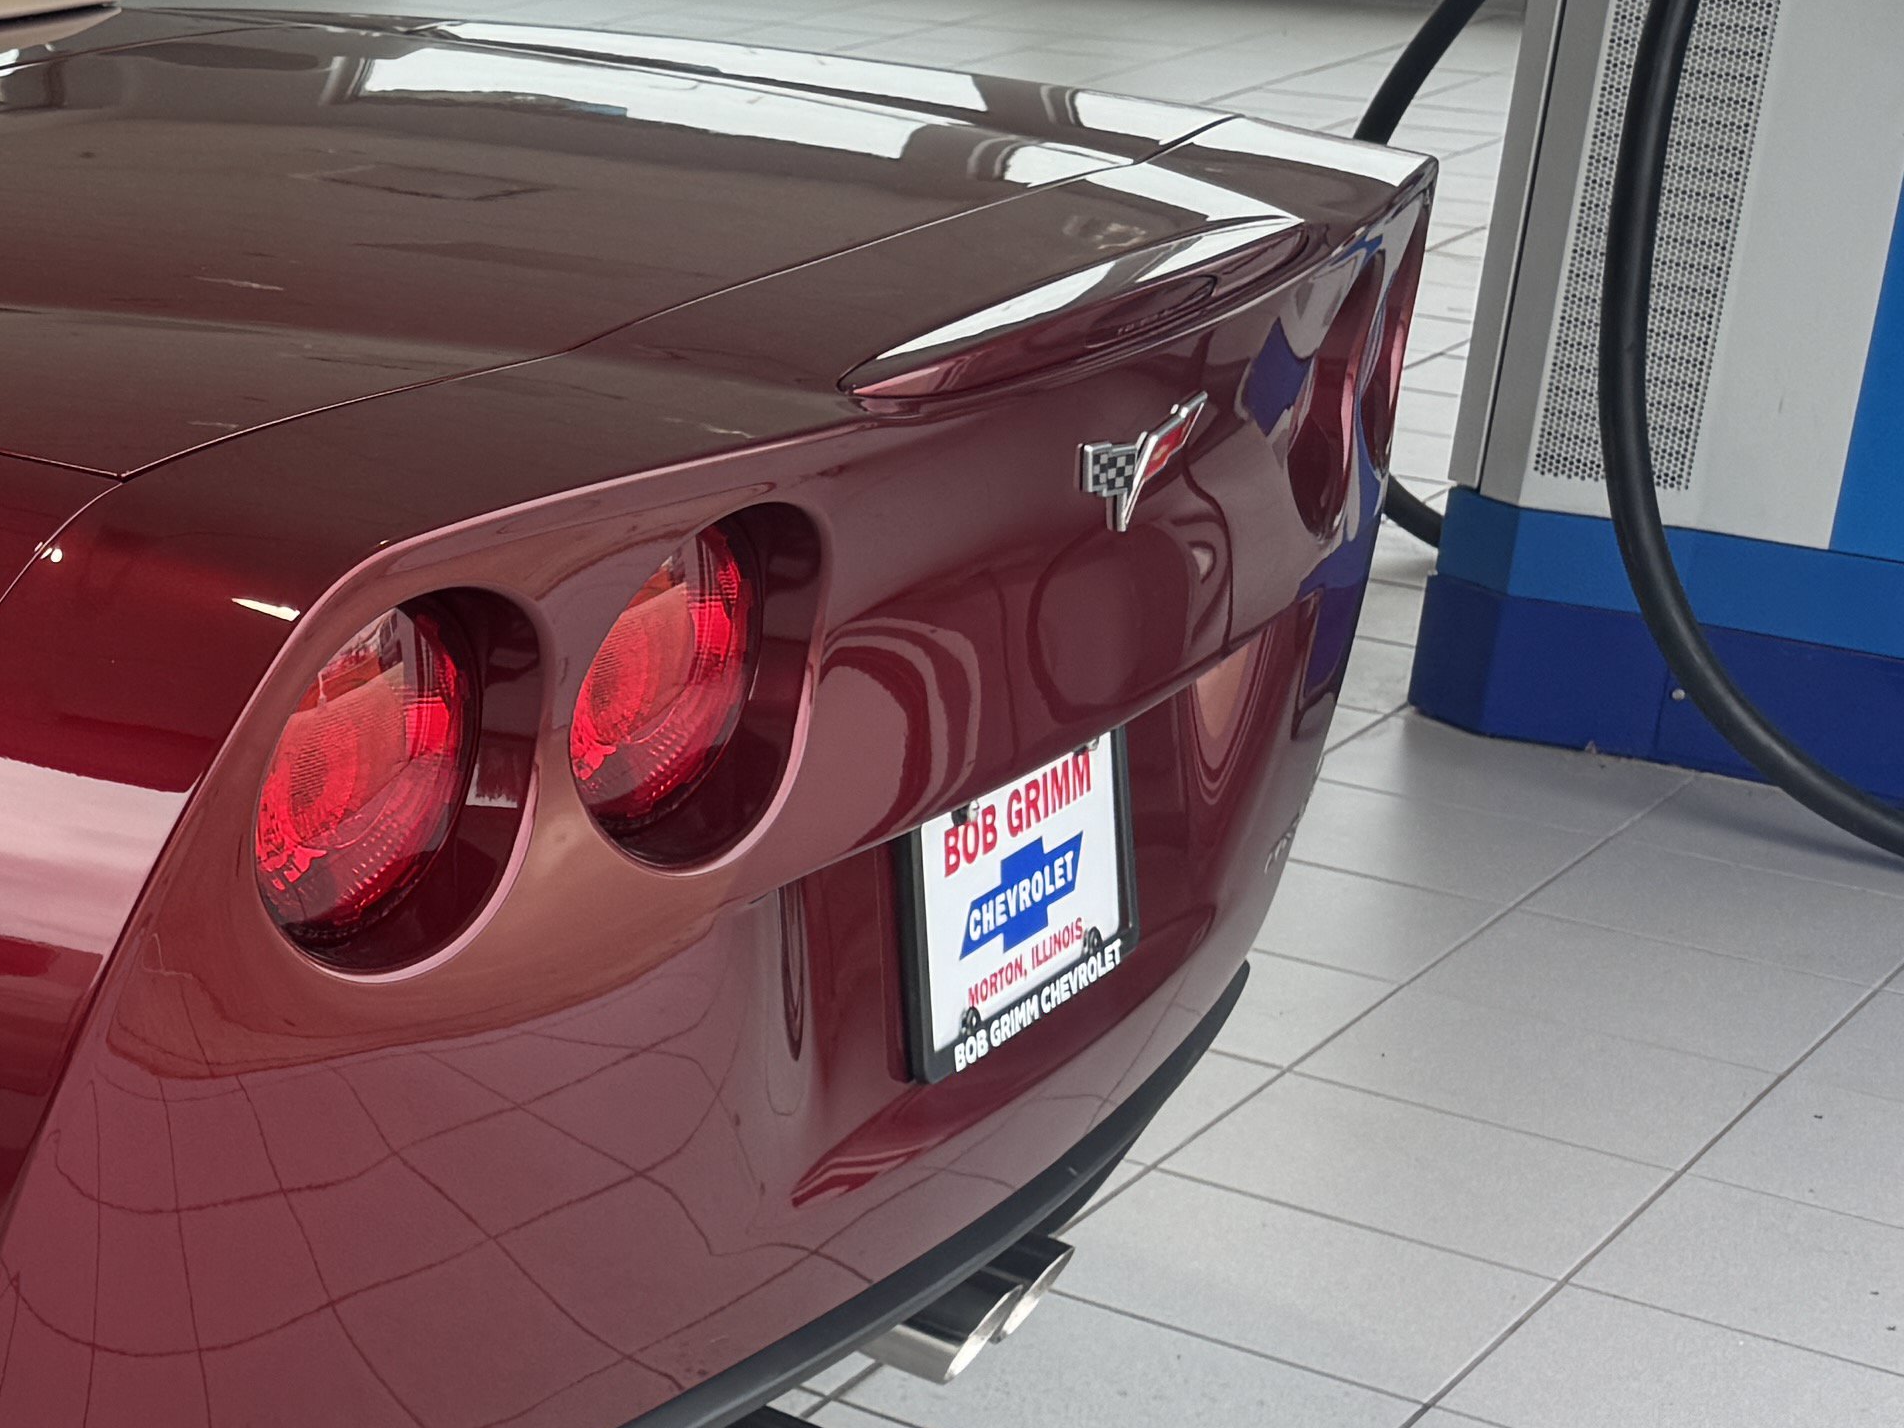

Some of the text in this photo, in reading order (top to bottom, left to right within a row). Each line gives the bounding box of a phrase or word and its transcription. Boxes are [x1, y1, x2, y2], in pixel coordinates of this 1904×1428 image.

[944, 749, 1092, 878] BOB GRIMM
[968, 850, 1075, 942] CHEVROLET
[954, 938, 1122, 1072] BOB GRIMM CHEVROLET
[968, 917, 1083, 1008] MORTON, ILLINOIS
